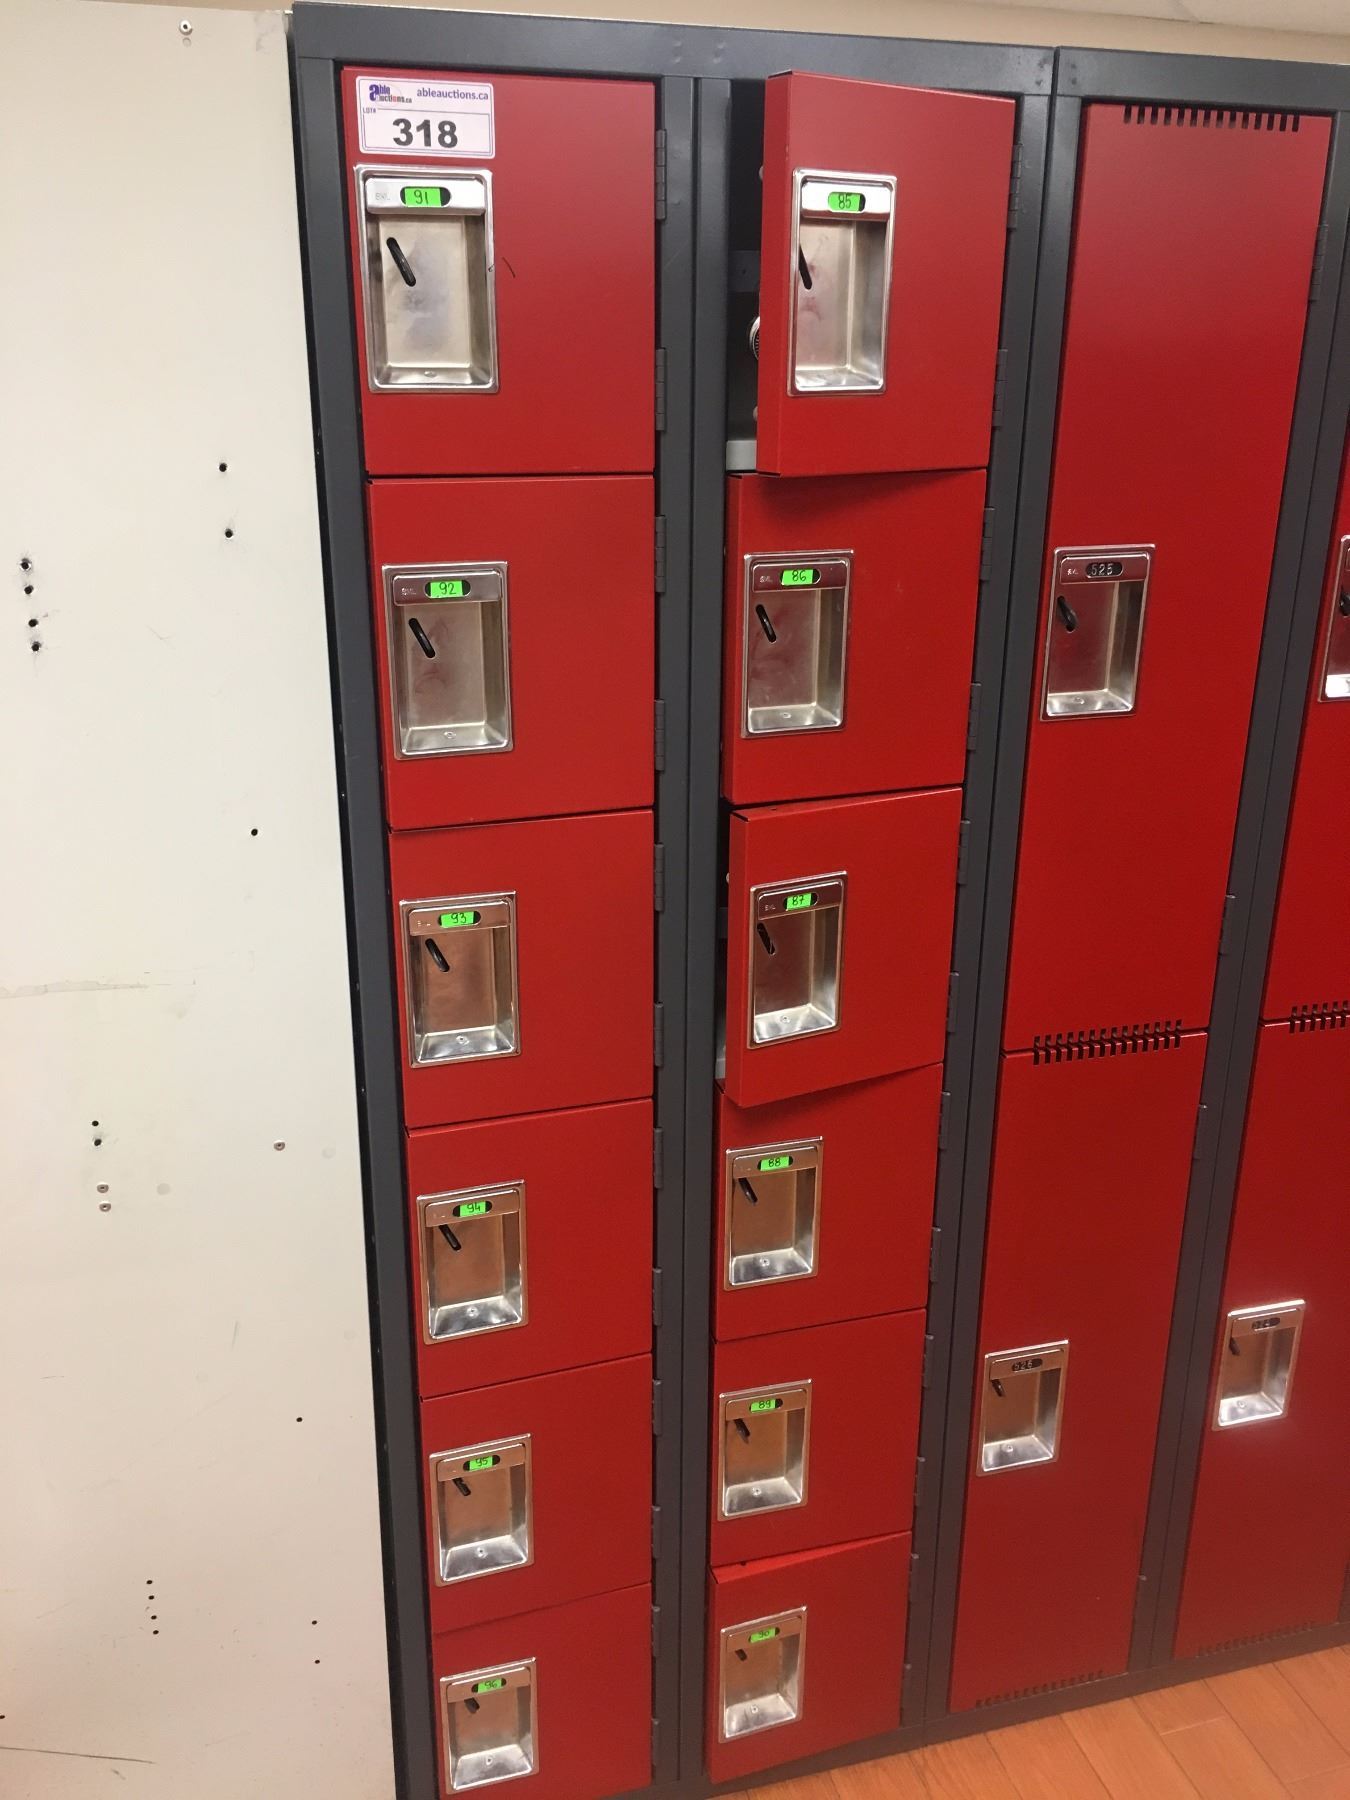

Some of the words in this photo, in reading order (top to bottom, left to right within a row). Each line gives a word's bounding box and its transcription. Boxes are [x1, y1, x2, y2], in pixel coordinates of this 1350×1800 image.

[417, 87, 489, 101] ableauctions.ca
[392, 118, 458, 149] 318
[413, 189, 429, 206] 91
[838, 193, 852, 210] 85
[1090, 563, 1114, 576] 525
[791, 570, 807, 583] 86
[439, 581, 457, 595] 92
[791, 894, 805, 907] 87
[450, 912, 467, 925] 93
[768, 1158, 781, 1168] 88
[466, 1202, 481, 1214] 94
[758, 1400, 772, 1410] 89
[475, 1456, 489, 1468] 95
